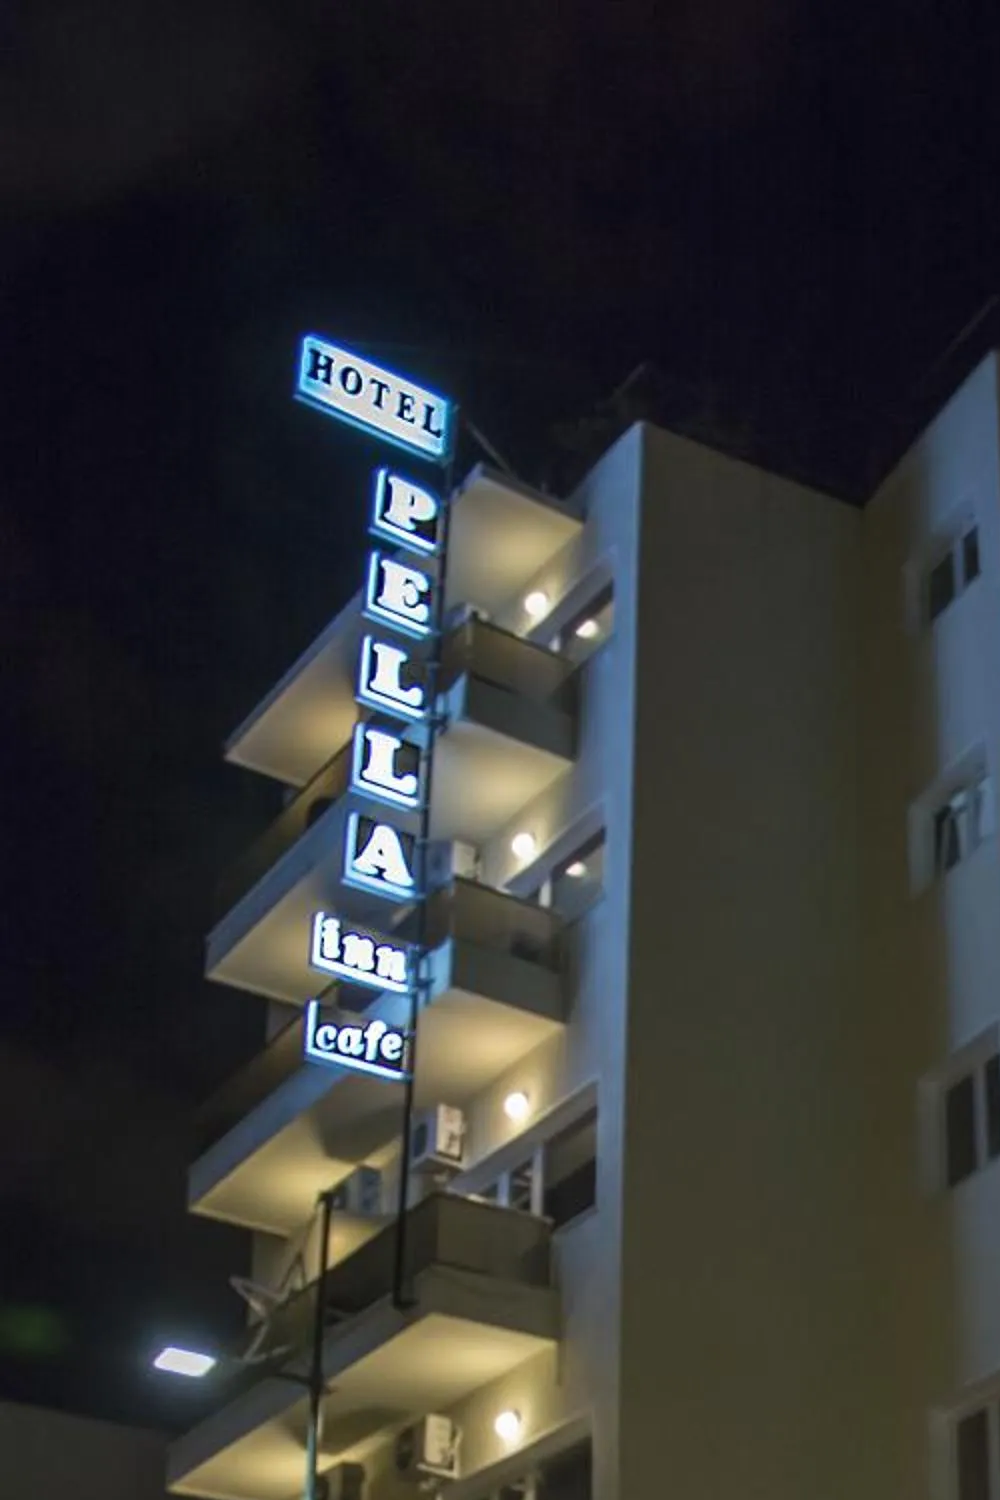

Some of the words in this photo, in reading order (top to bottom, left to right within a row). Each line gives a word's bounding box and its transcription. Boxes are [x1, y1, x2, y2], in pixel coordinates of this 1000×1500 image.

[307, 349, 442, 438] HOTEL
[353, 475, 437, 887] PELLA
[322, 917, 407, 983] inn
[315, 1019, 403, 1061] cafe
